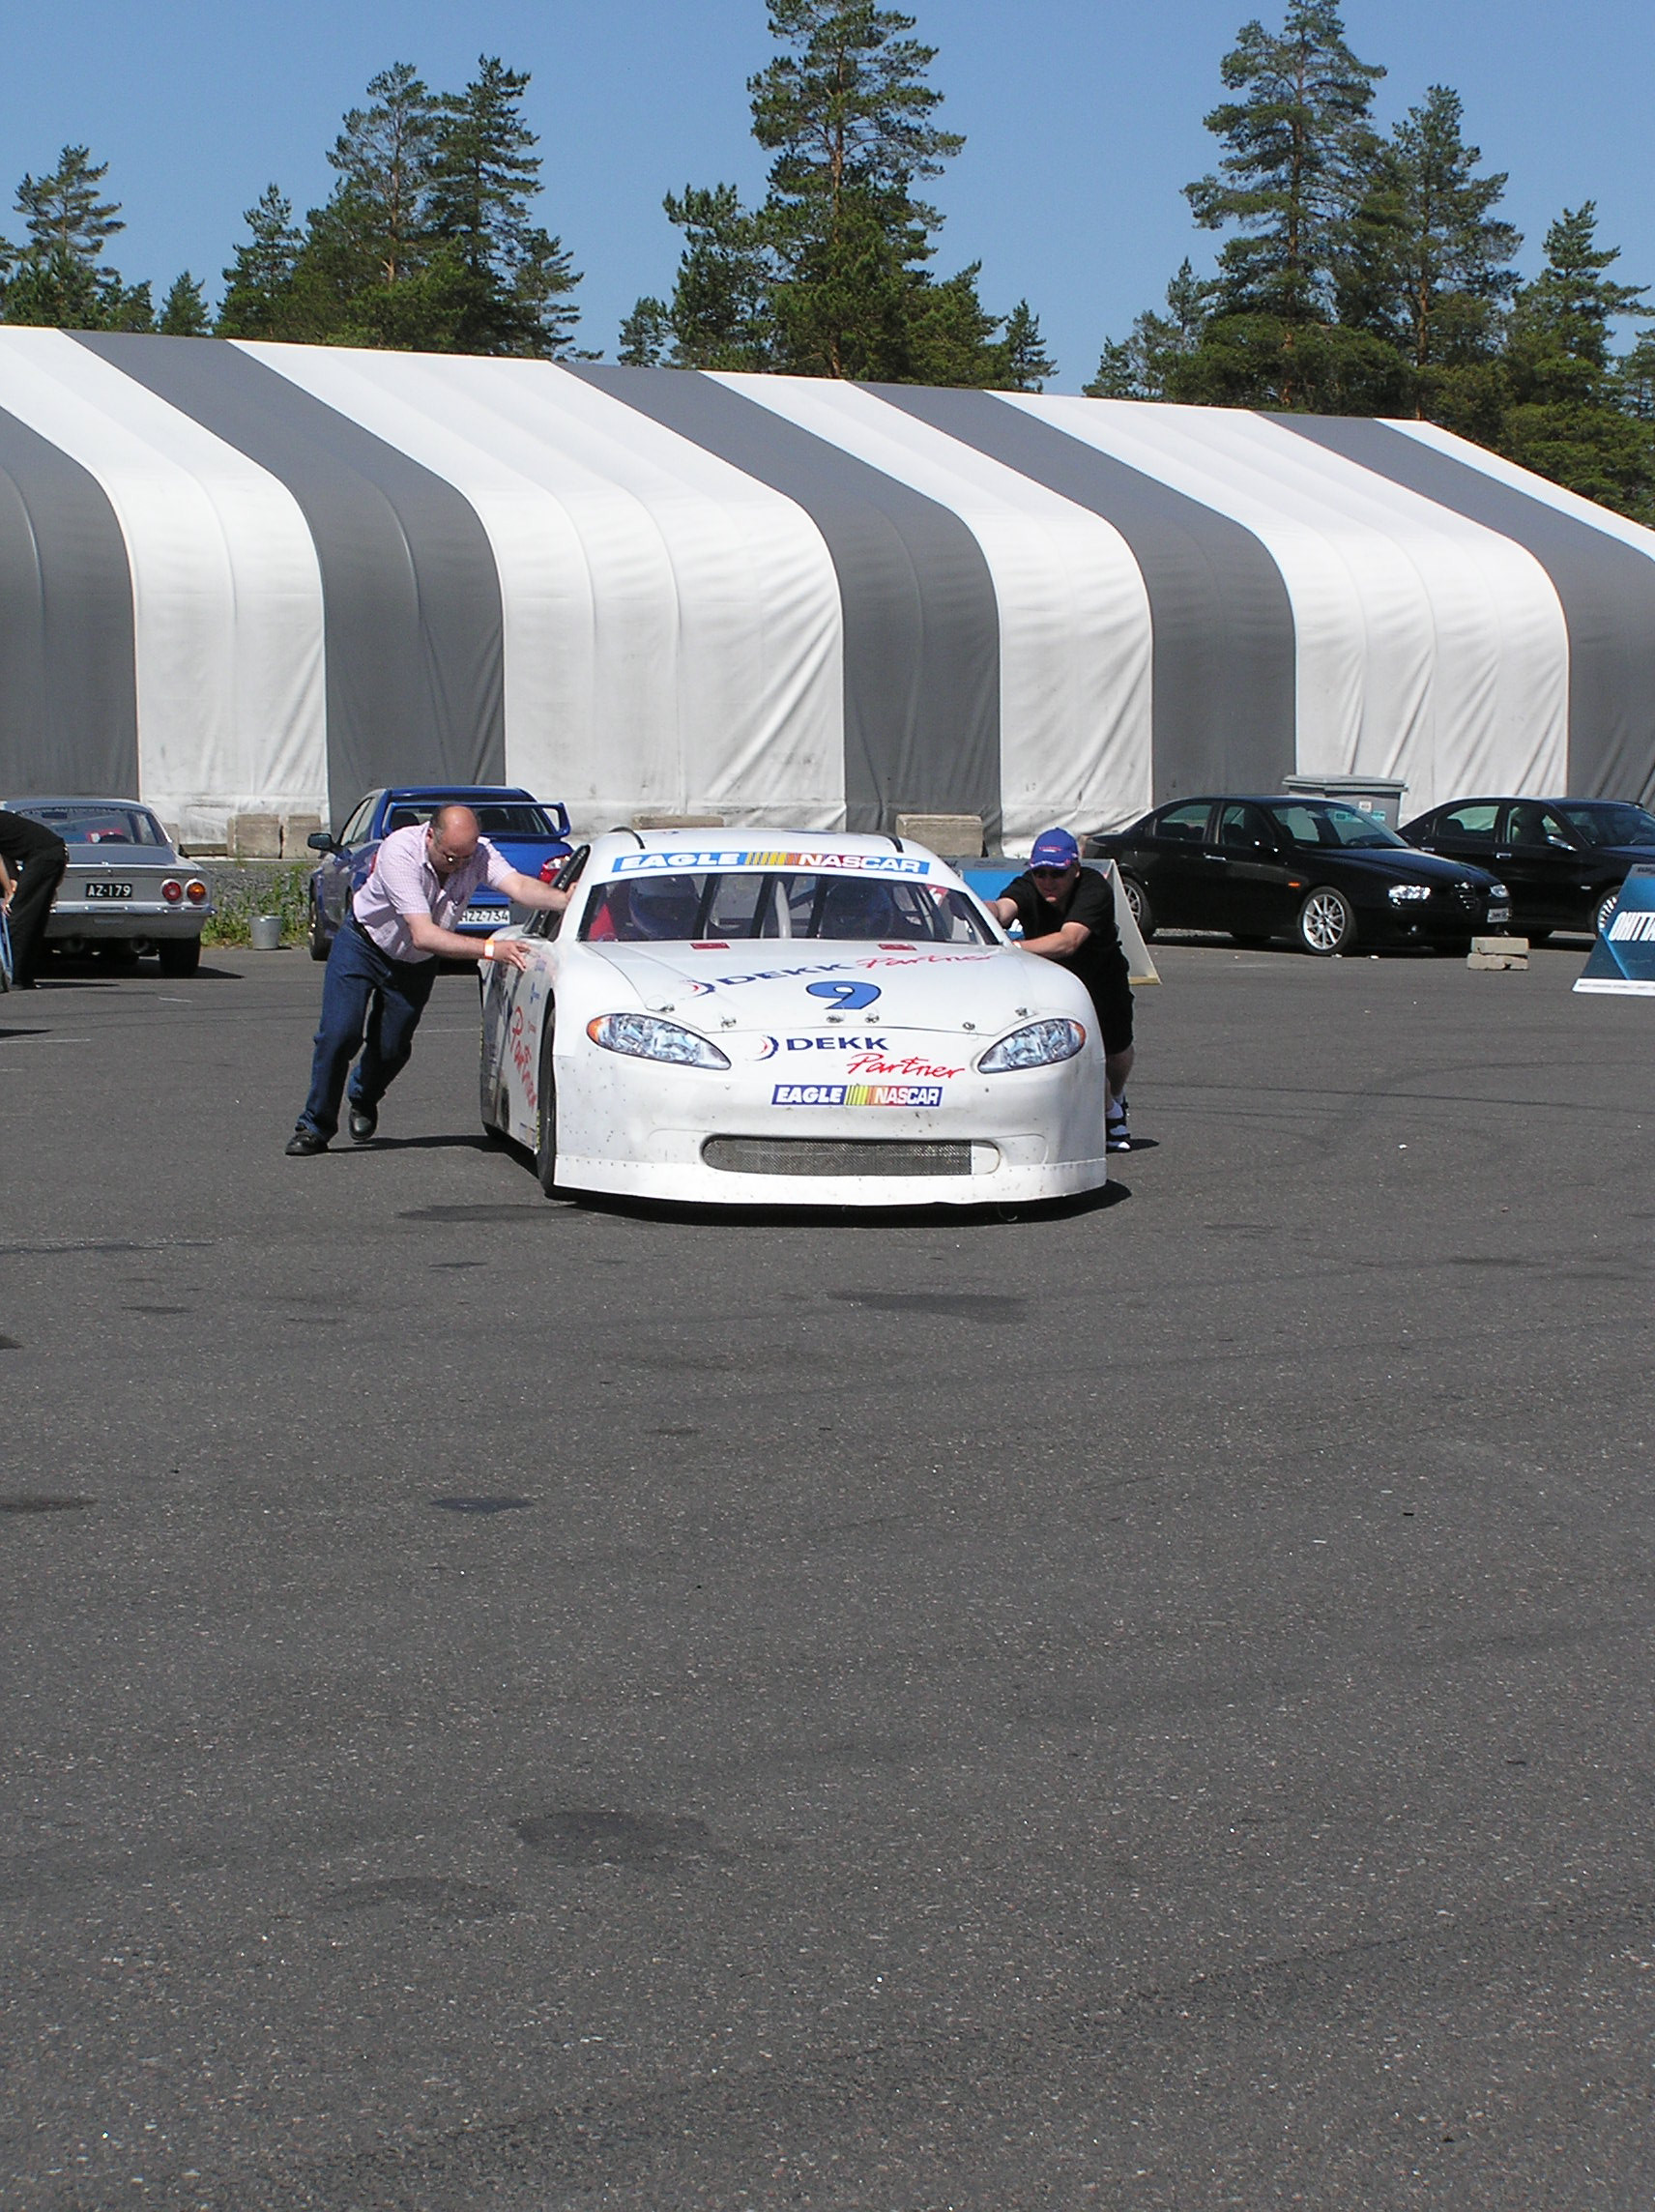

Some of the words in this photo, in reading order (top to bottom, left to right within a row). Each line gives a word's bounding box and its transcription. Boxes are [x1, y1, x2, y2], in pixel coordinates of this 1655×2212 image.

[620, 852, 740, 870] EAGLE
[798, 854, 921, 873] NASCAR
[87, 884, 131, 897] AZ-179
[715, 963, 856, 986] DEKK
[856, 954, 993, 969] Partner
[805, 979, 883, 1010] 9
[786, 1036, 889, 1051] DEKK
[846, 1052, 966, 1079] Partner
[775, 1086, 844, 1103] EAGLE
[874, 1087, 941, 1105] NASCAR
